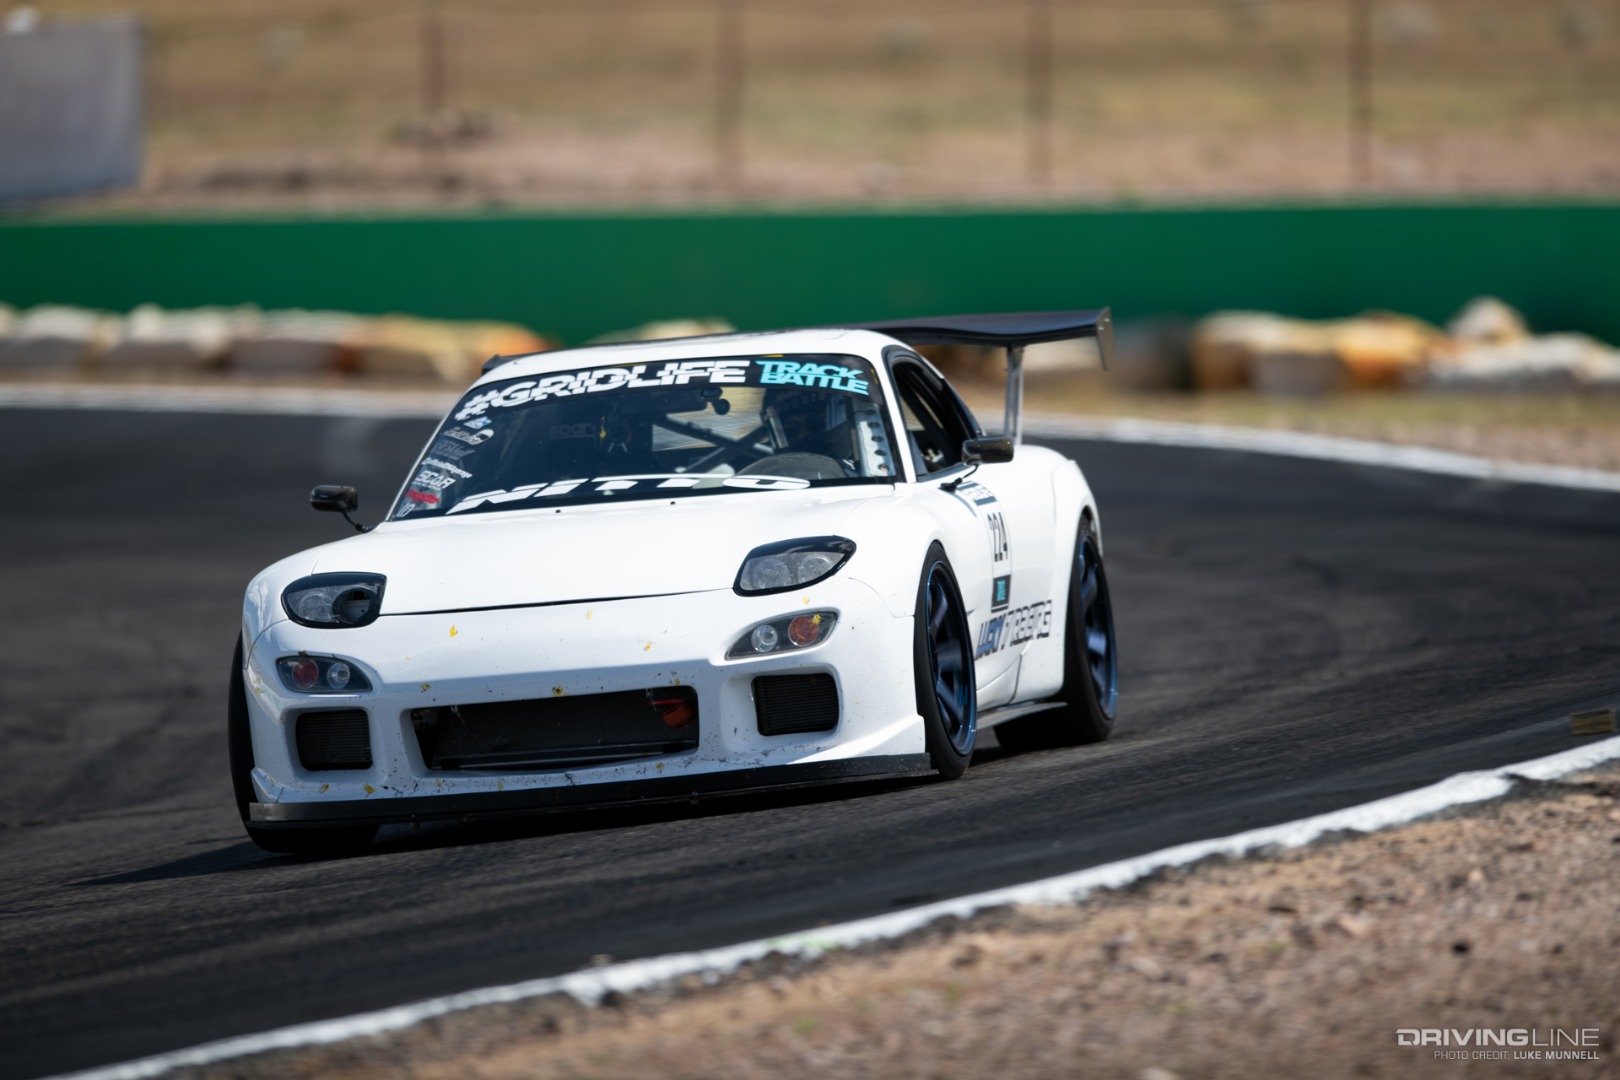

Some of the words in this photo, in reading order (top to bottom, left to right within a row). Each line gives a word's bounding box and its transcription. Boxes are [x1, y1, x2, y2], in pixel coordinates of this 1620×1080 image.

[454, 360, 750, 421] #GRIDLIFE
[755, 360, 863, 379] TRACK
[760, 373, 870, 396] BATTLE
[446, 473, 811, 515] NITTO
[987, 511, 1008, 562] 224
